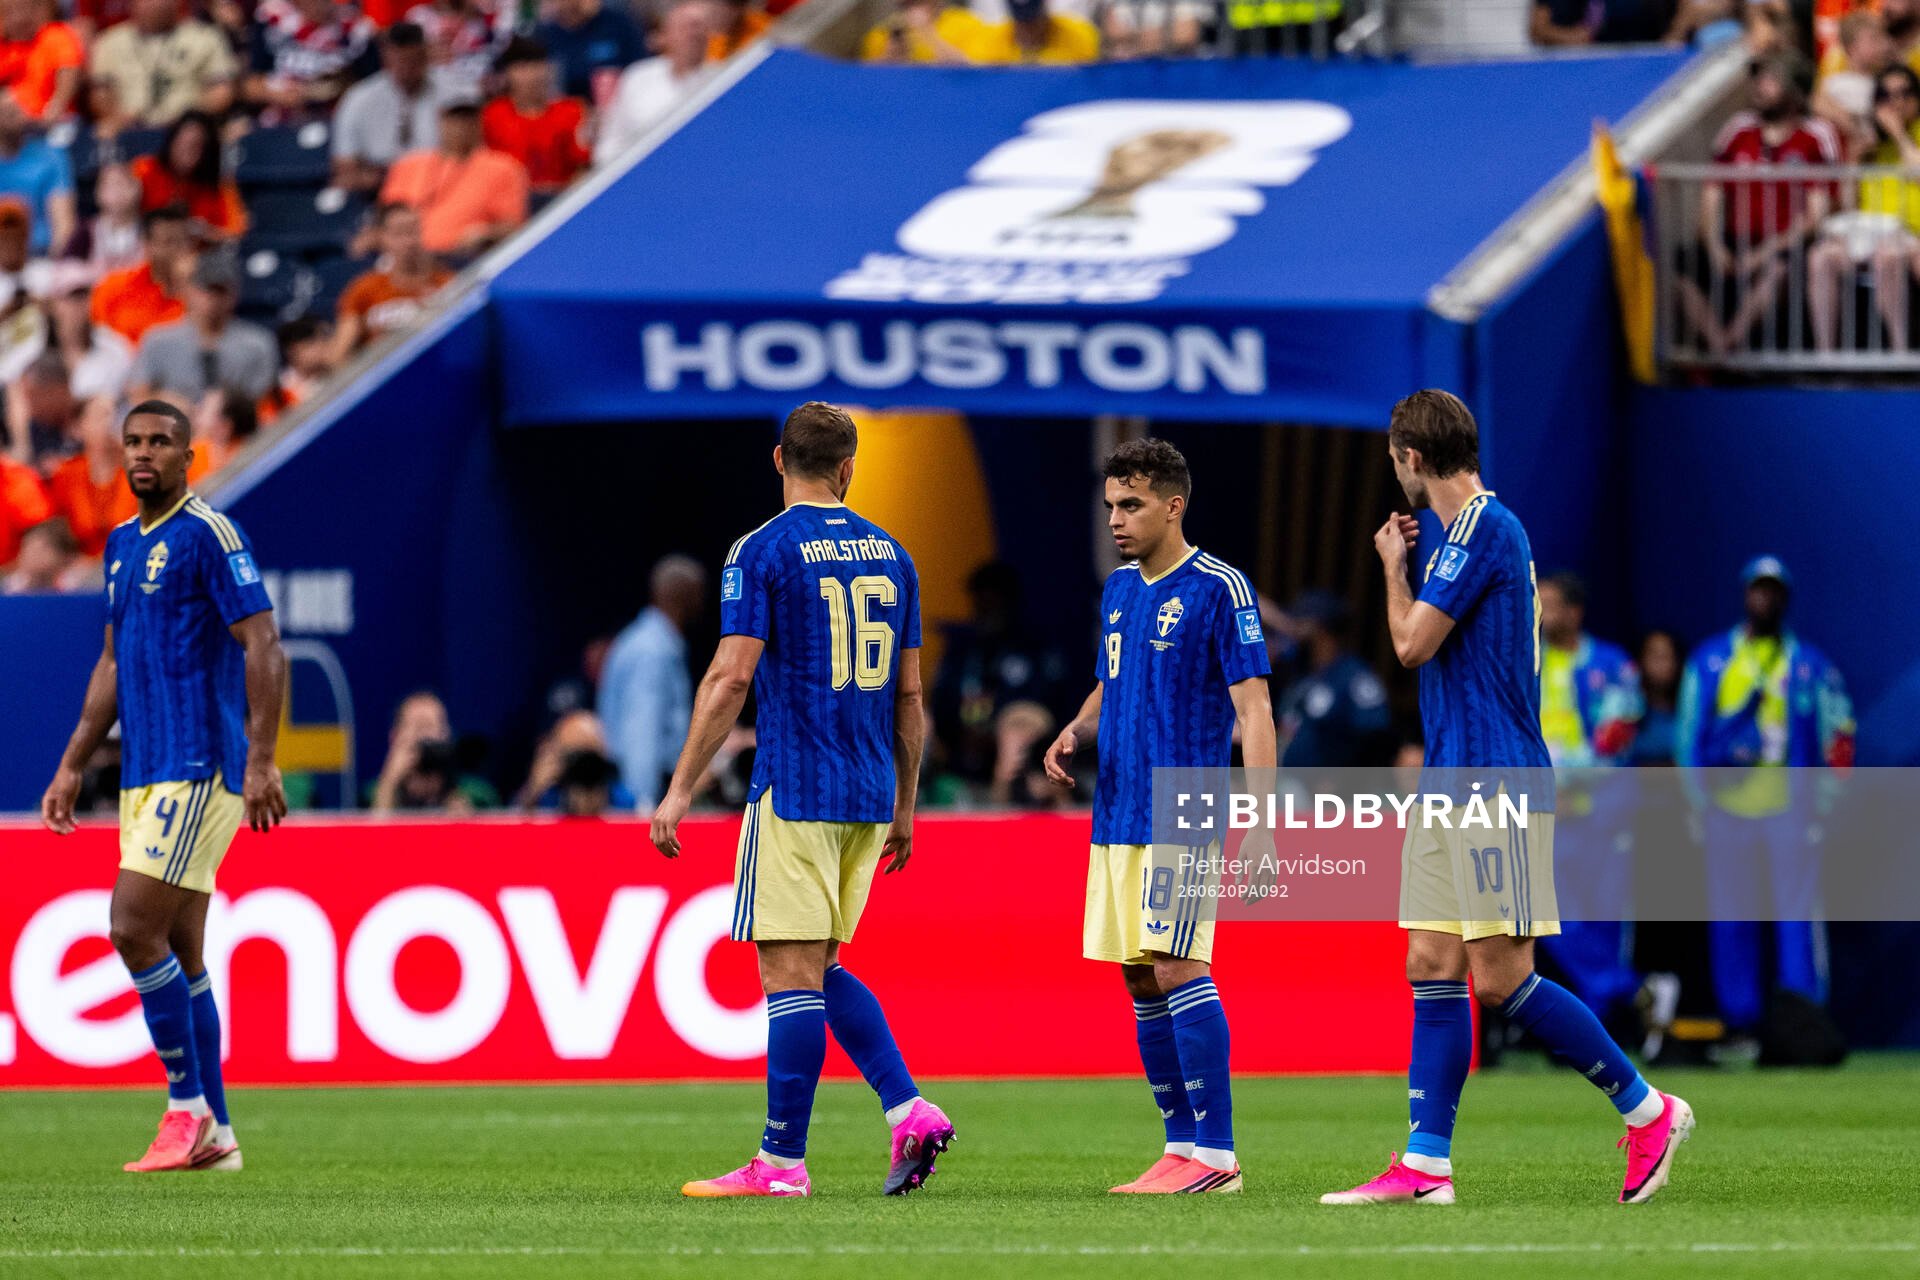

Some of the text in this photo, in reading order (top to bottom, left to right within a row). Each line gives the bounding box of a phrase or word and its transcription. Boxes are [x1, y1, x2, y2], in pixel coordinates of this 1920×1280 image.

[642, 320, 1266, 395] HOUSTON
[799, 534, 897, 563] KARLSTRÖM
[819, 575, 898, 691] 16
[155, 796, 179, 838] 4
[1469, 847, 1503, 893] 10
[0, 884, 768, 1067] enovo
